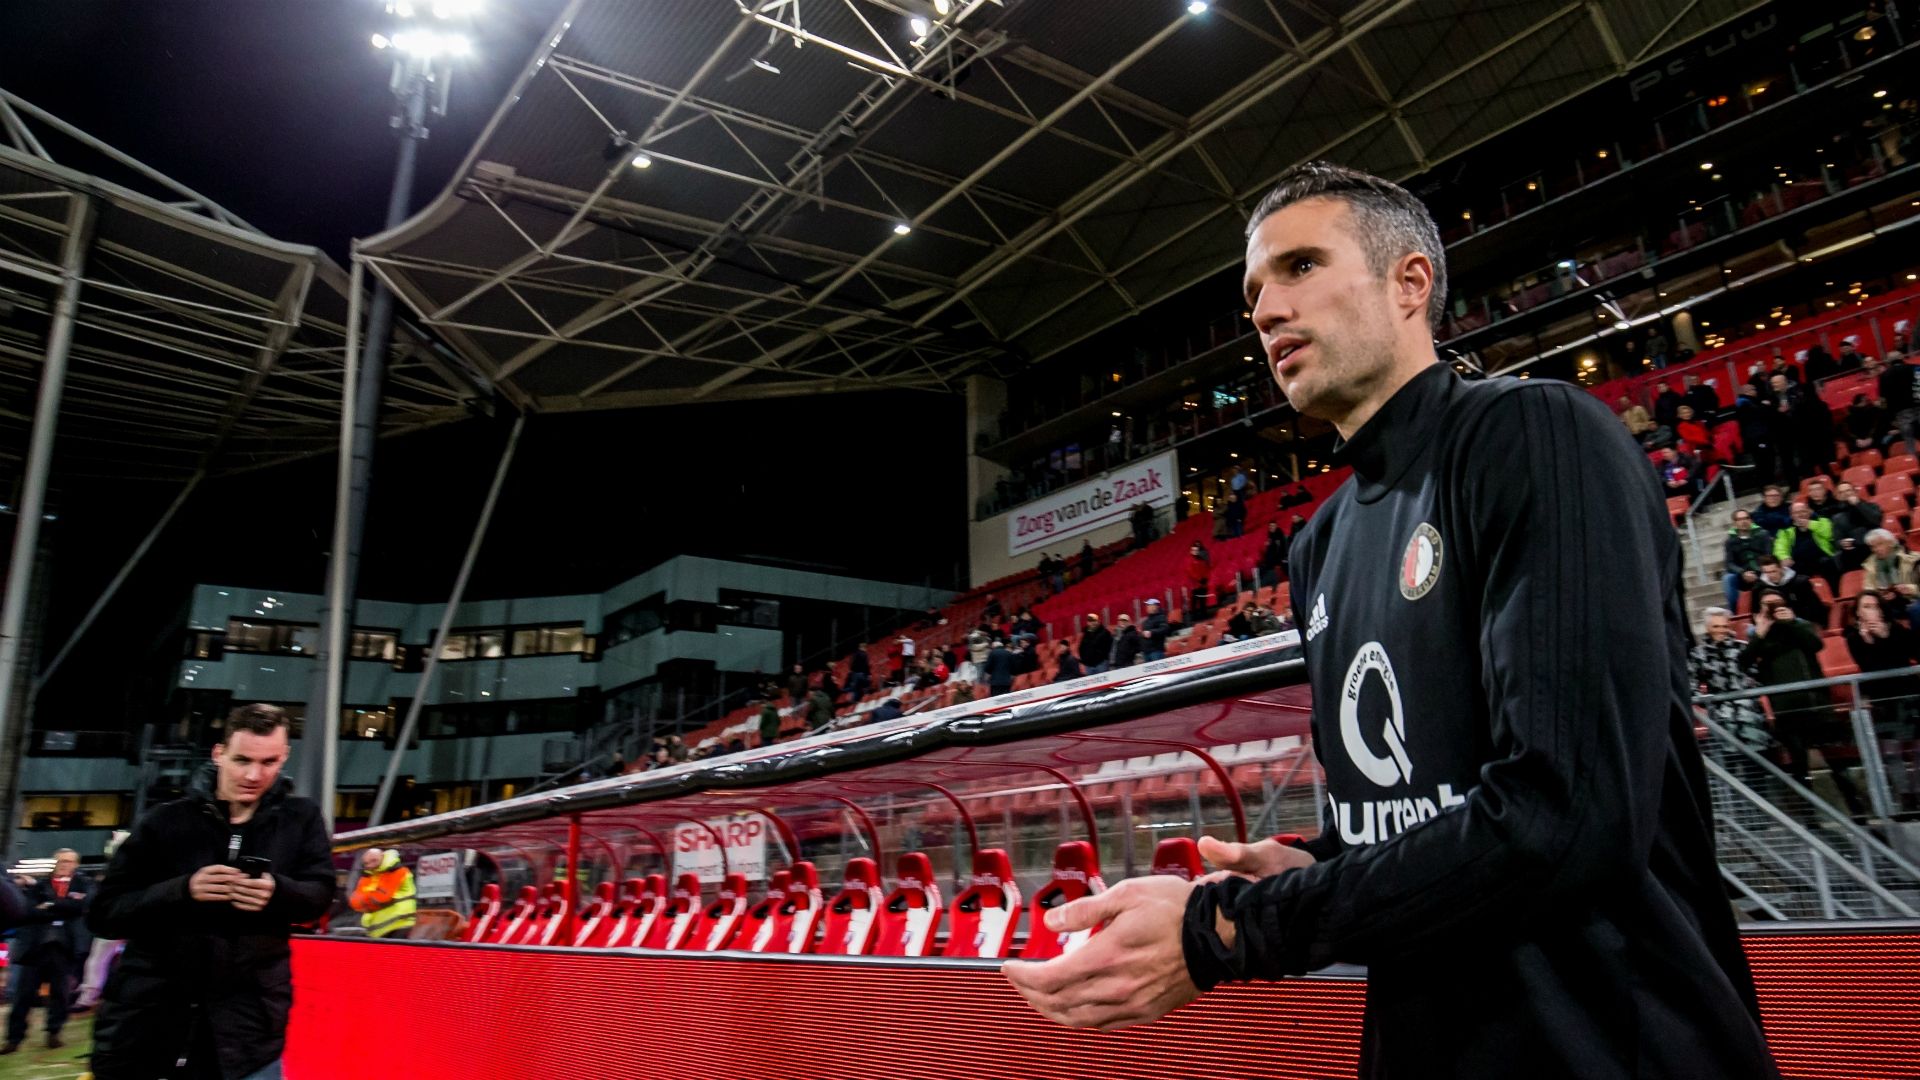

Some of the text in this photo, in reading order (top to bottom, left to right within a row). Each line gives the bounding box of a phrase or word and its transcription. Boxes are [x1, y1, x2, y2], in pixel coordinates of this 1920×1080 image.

[1016, 468, 1163, 537] Zorg van de Zaak
[679, 821, 761, 853] SHARP
[1328, 784, 1466, 845] urrent
